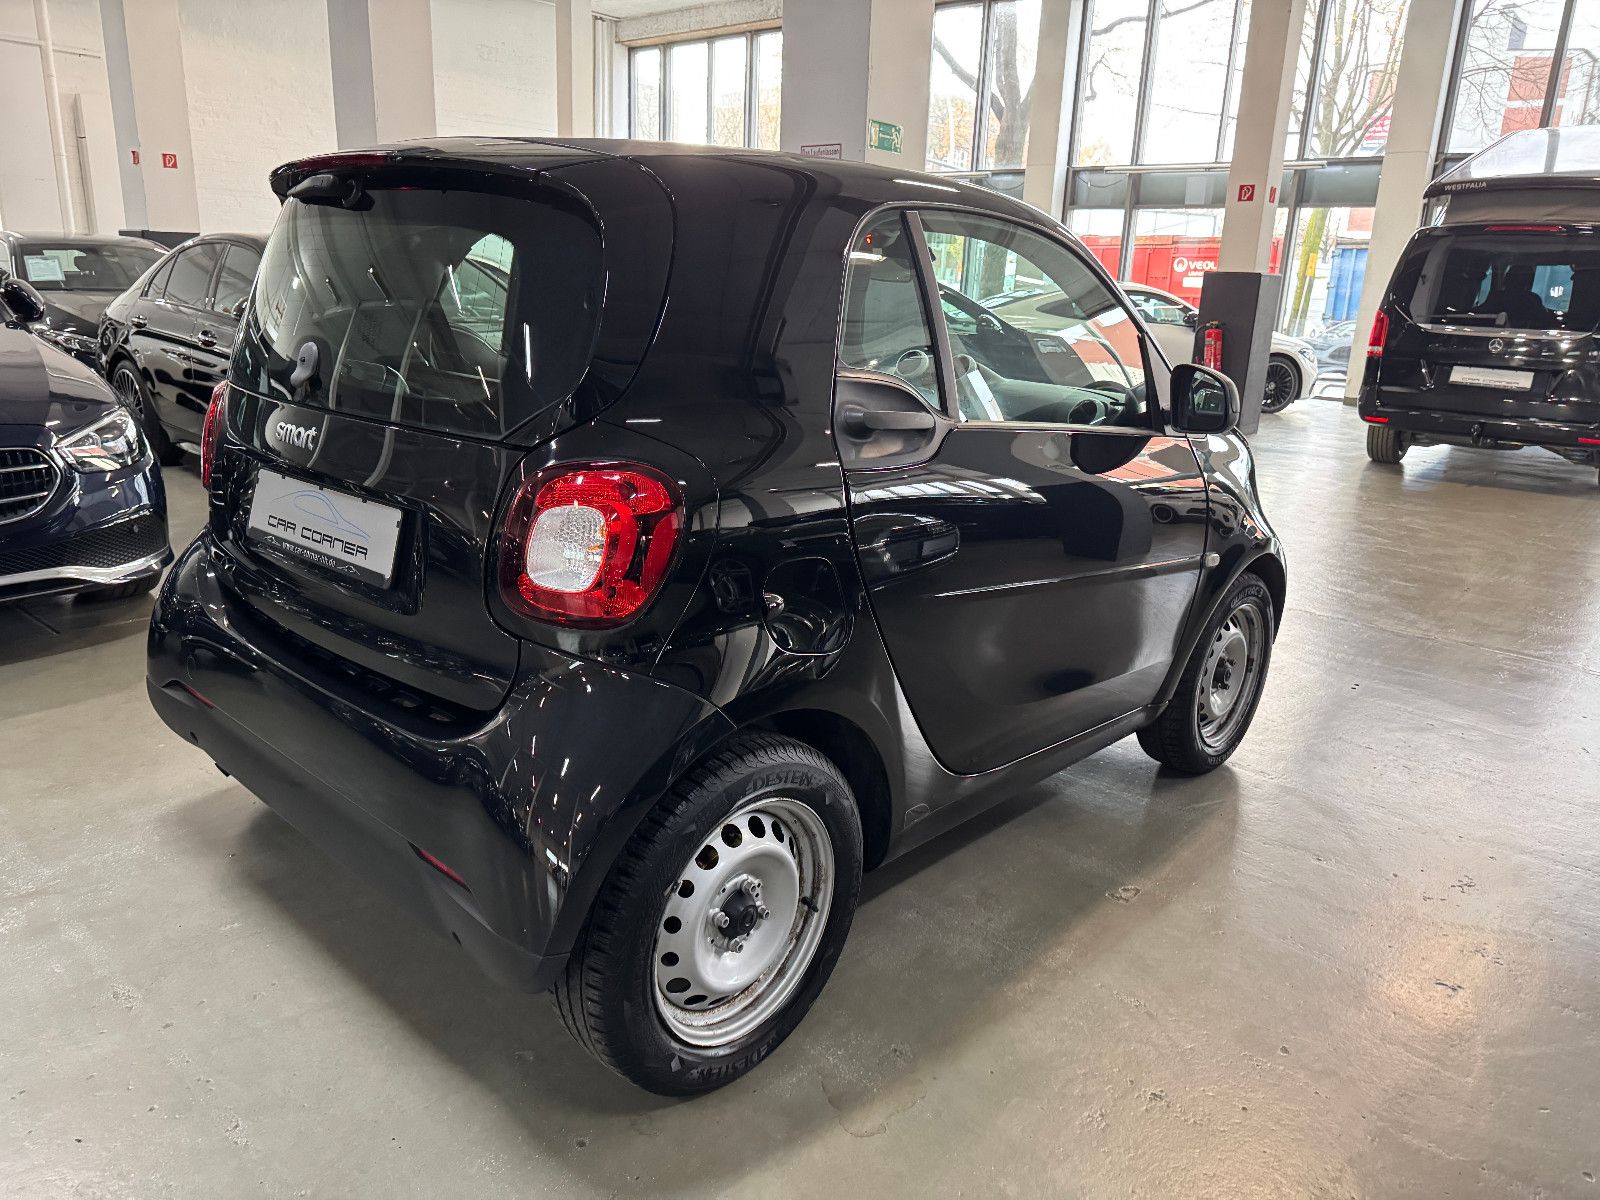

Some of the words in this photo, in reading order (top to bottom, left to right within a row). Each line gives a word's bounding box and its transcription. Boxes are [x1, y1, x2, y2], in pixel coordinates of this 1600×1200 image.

[1444, 181, 1487, 191] WESTFALIA
[275, 421, 318, 451] smart
[267, 515, 297, 535] CAR
[301, 526, 368, 561] CORNER
